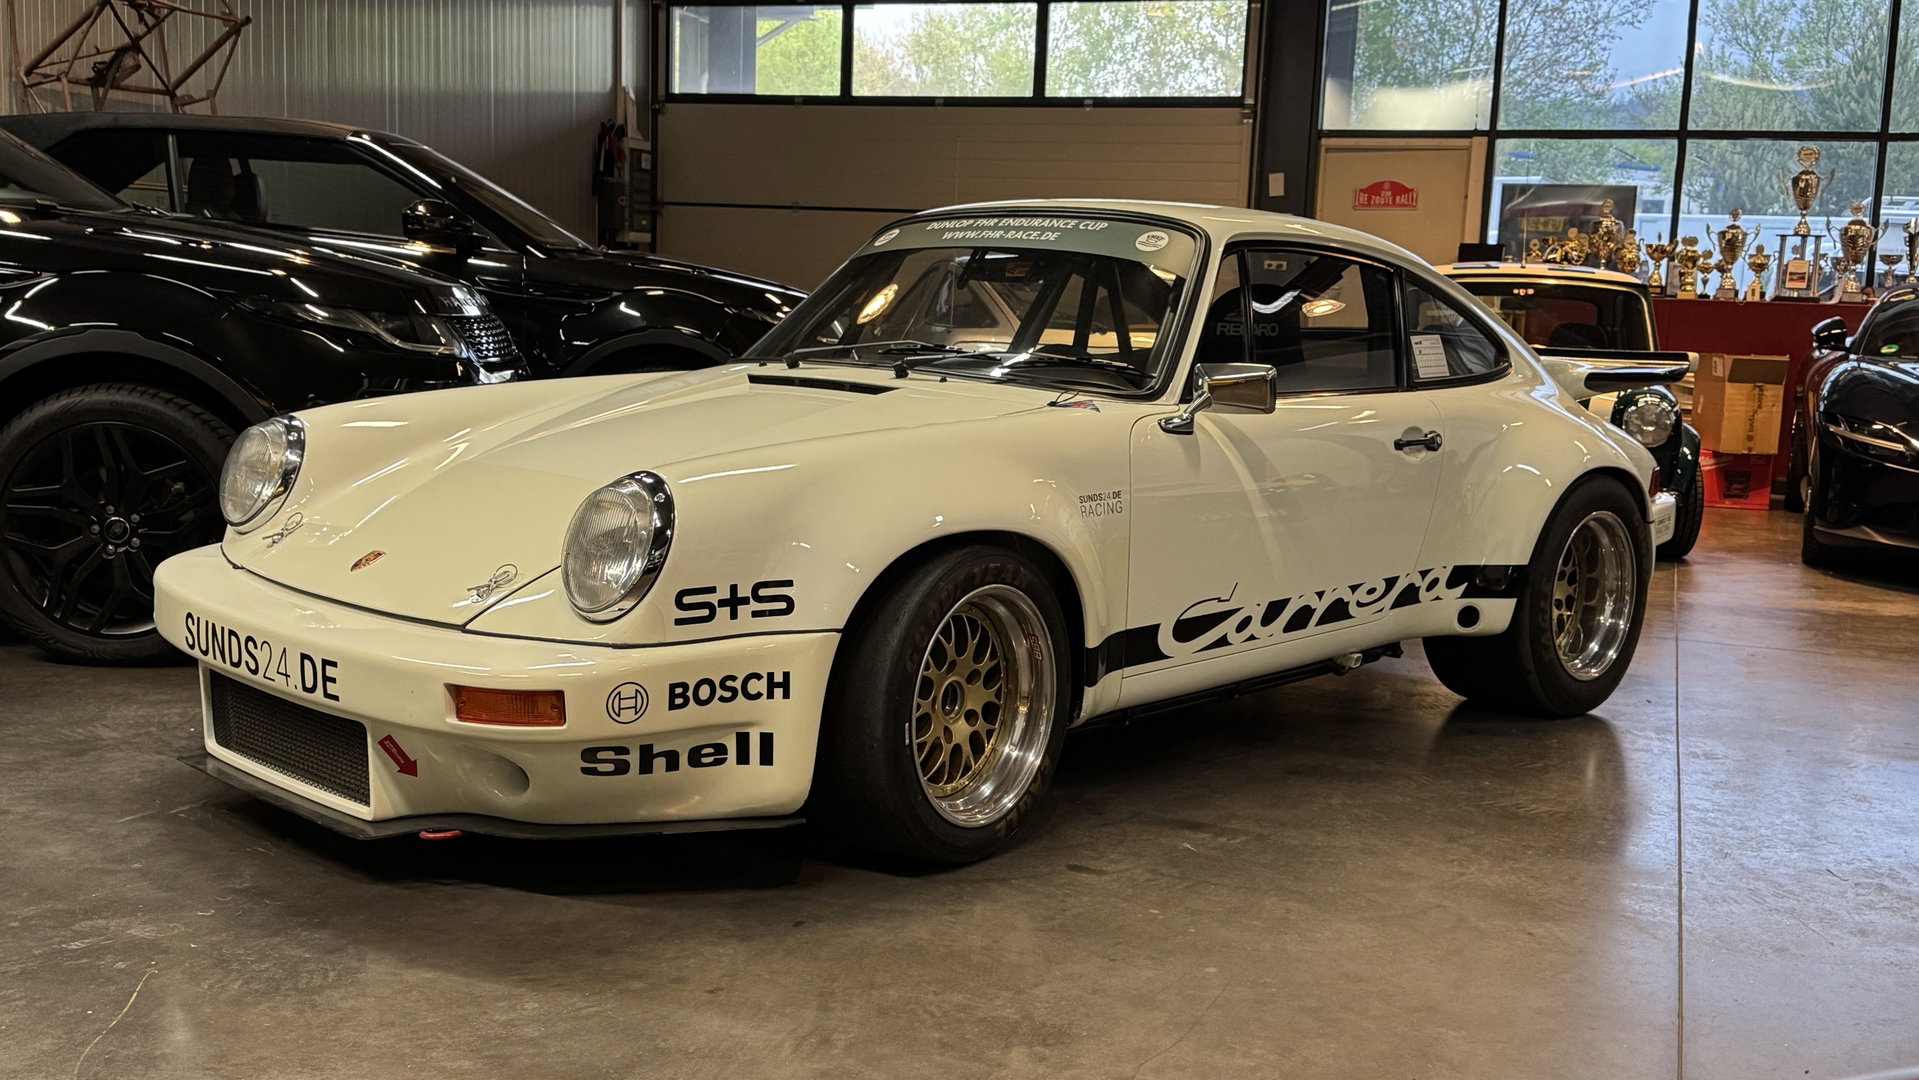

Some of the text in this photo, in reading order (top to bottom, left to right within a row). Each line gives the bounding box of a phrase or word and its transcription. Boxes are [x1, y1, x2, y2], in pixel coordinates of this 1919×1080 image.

[926, 218, 1109, 232] DUNLOP FHR ENDURANCE CUP
[942, 230, 1062, 241] WWW.FHR-RACE.DE
[1080, 500, 1123, 519] RACING
[674, 579, 796, 627] S+S
[1157, 566, 1469, 659] Carrera
[185, 611, 340, 703] SUNDS24.DE
[668, 671, 791, 712] BOSCH
[580, 731, 774, 777] Shell
